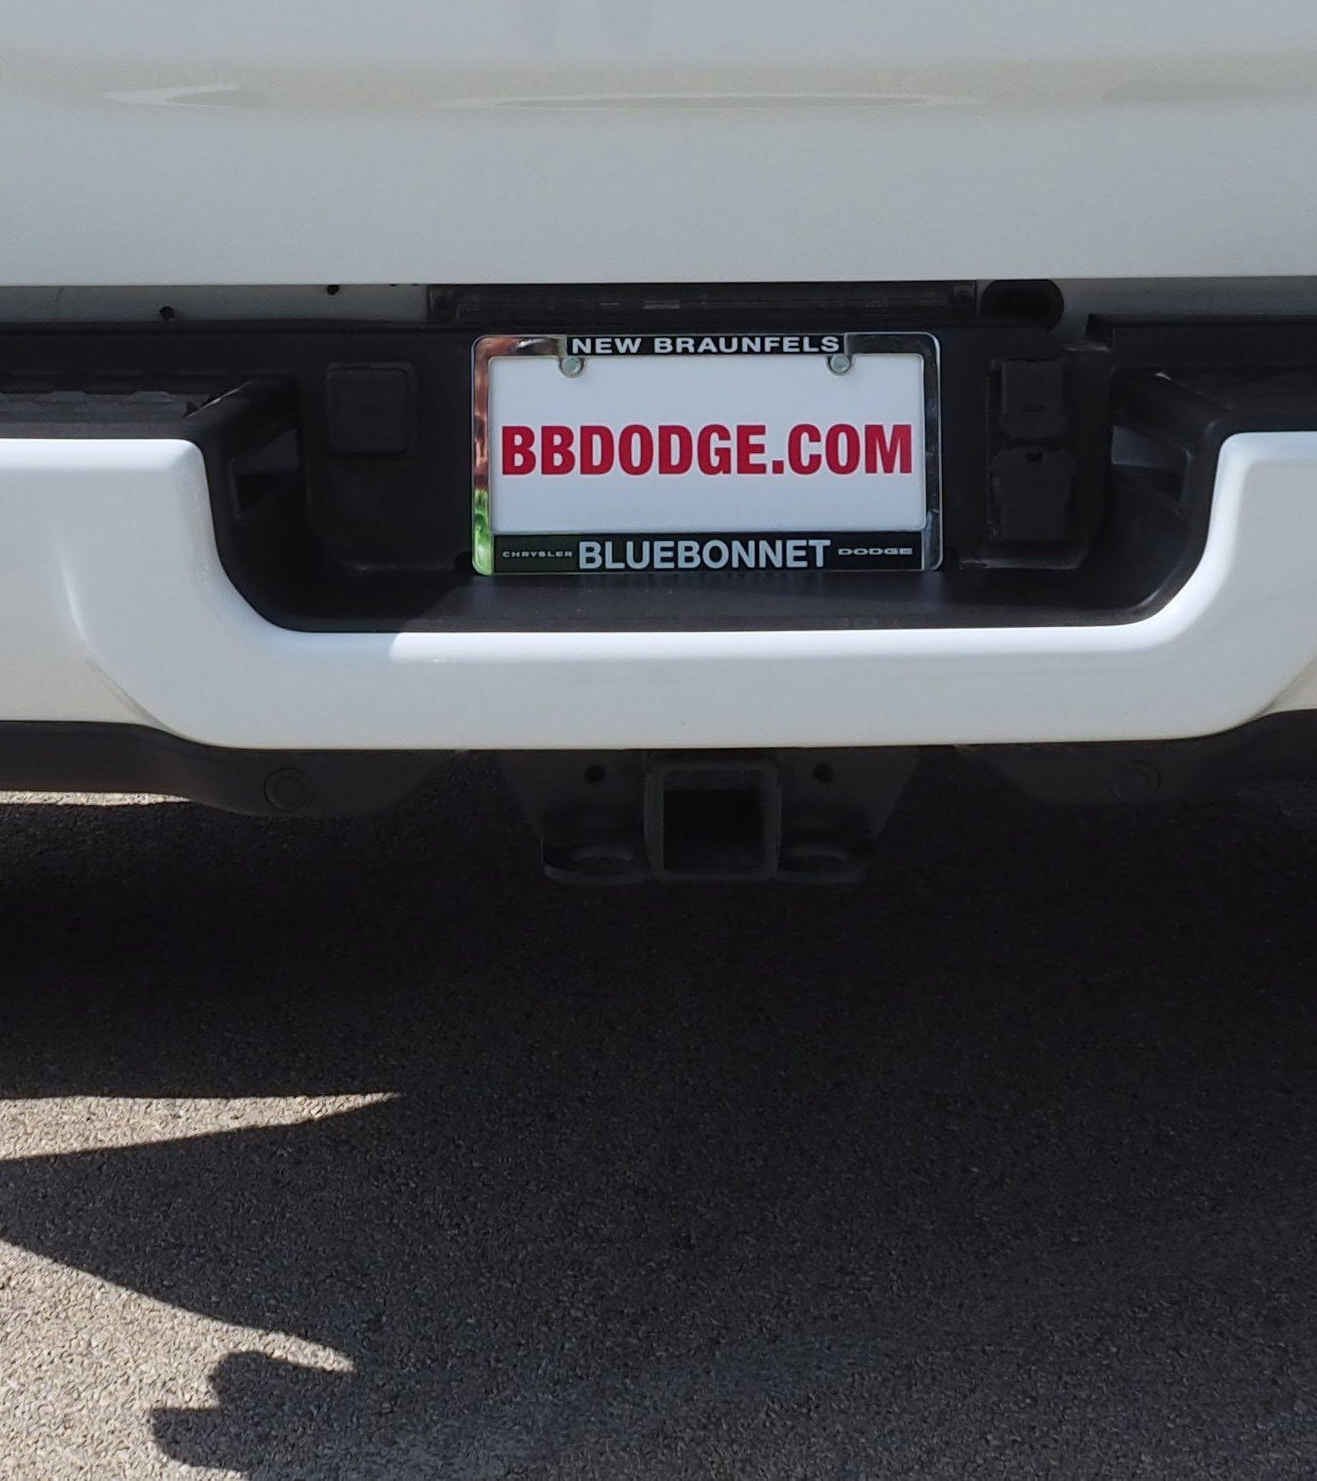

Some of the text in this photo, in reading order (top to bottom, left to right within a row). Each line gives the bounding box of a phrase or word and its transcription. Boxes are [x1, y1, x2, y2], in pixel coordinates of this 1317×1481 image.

[572, 335, 841, 354] NEW BRAUNFELS
[501, 423, 913, 476] BBDODGE.COM
[502, 539, 913, 570] CHRYSLER BLUEBONNET DODGE
